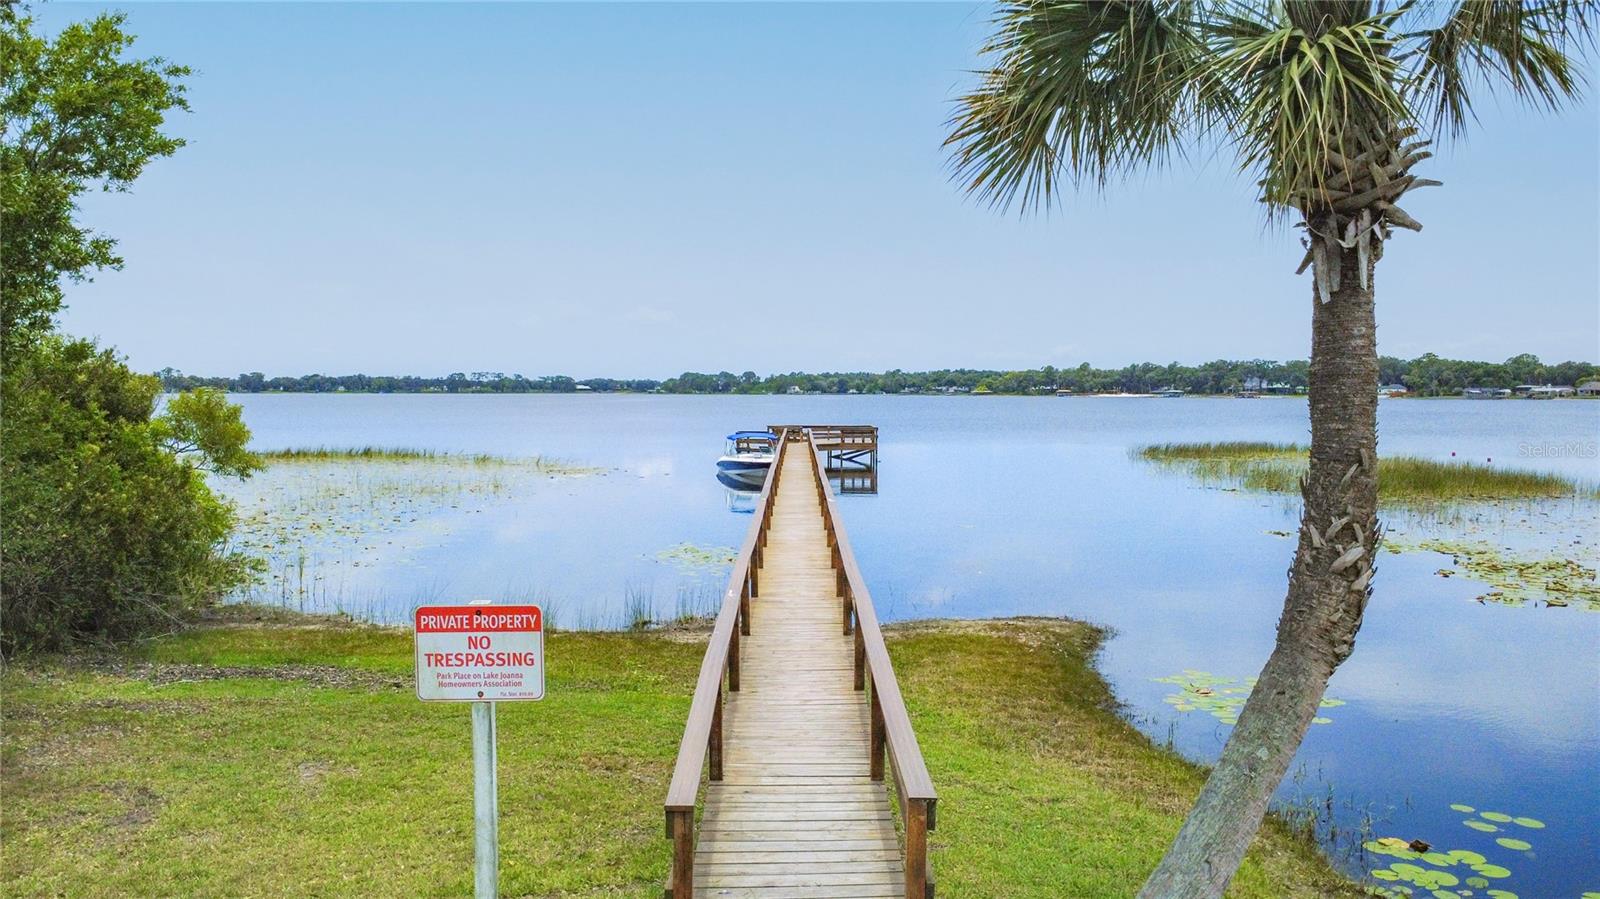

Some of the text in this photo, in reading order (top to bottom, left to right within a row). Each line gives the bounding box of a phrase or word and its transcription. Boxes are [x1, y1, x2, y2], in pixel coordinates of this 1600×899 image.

[420, 614, 537, 629] PRIVATE PROPERTY
[467, 635, 491, 650] NO
[424, 652, 535, 667] TRESPASSING
[436, 672, 453, 680] Park
[453, 672, 471, 680] Place
[483, 672, 499, 680] Lake
[500, 672, 523, 680] Joanna
[438, 680, 522, 688] Homeowners Association
